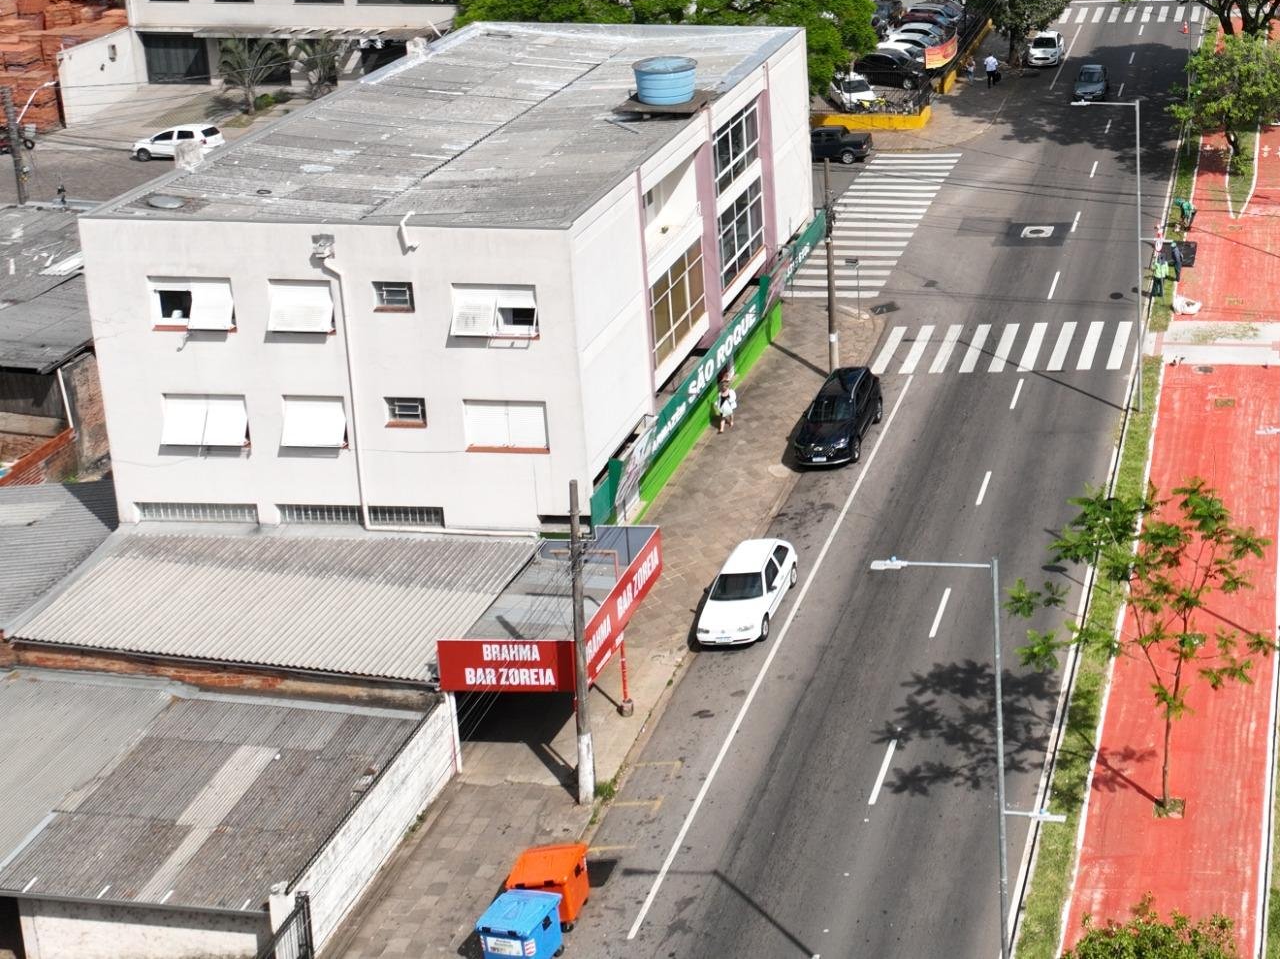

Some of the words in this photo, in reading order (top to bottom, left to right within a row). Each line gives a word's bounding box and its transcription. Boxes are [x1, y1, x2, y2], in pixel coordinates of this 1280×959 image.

[687, 358, 716, 405] SÃO
[716, 304, 758, 367] ROQUE
[616, 583, 633, 621] BAR
[633, 546, 659, 599] ZOREIA
[482, 643, 540, 662] BRAHMA
[464, 667, 496, 685] BAR
[499, 668, 556, 686] ZOREIA
